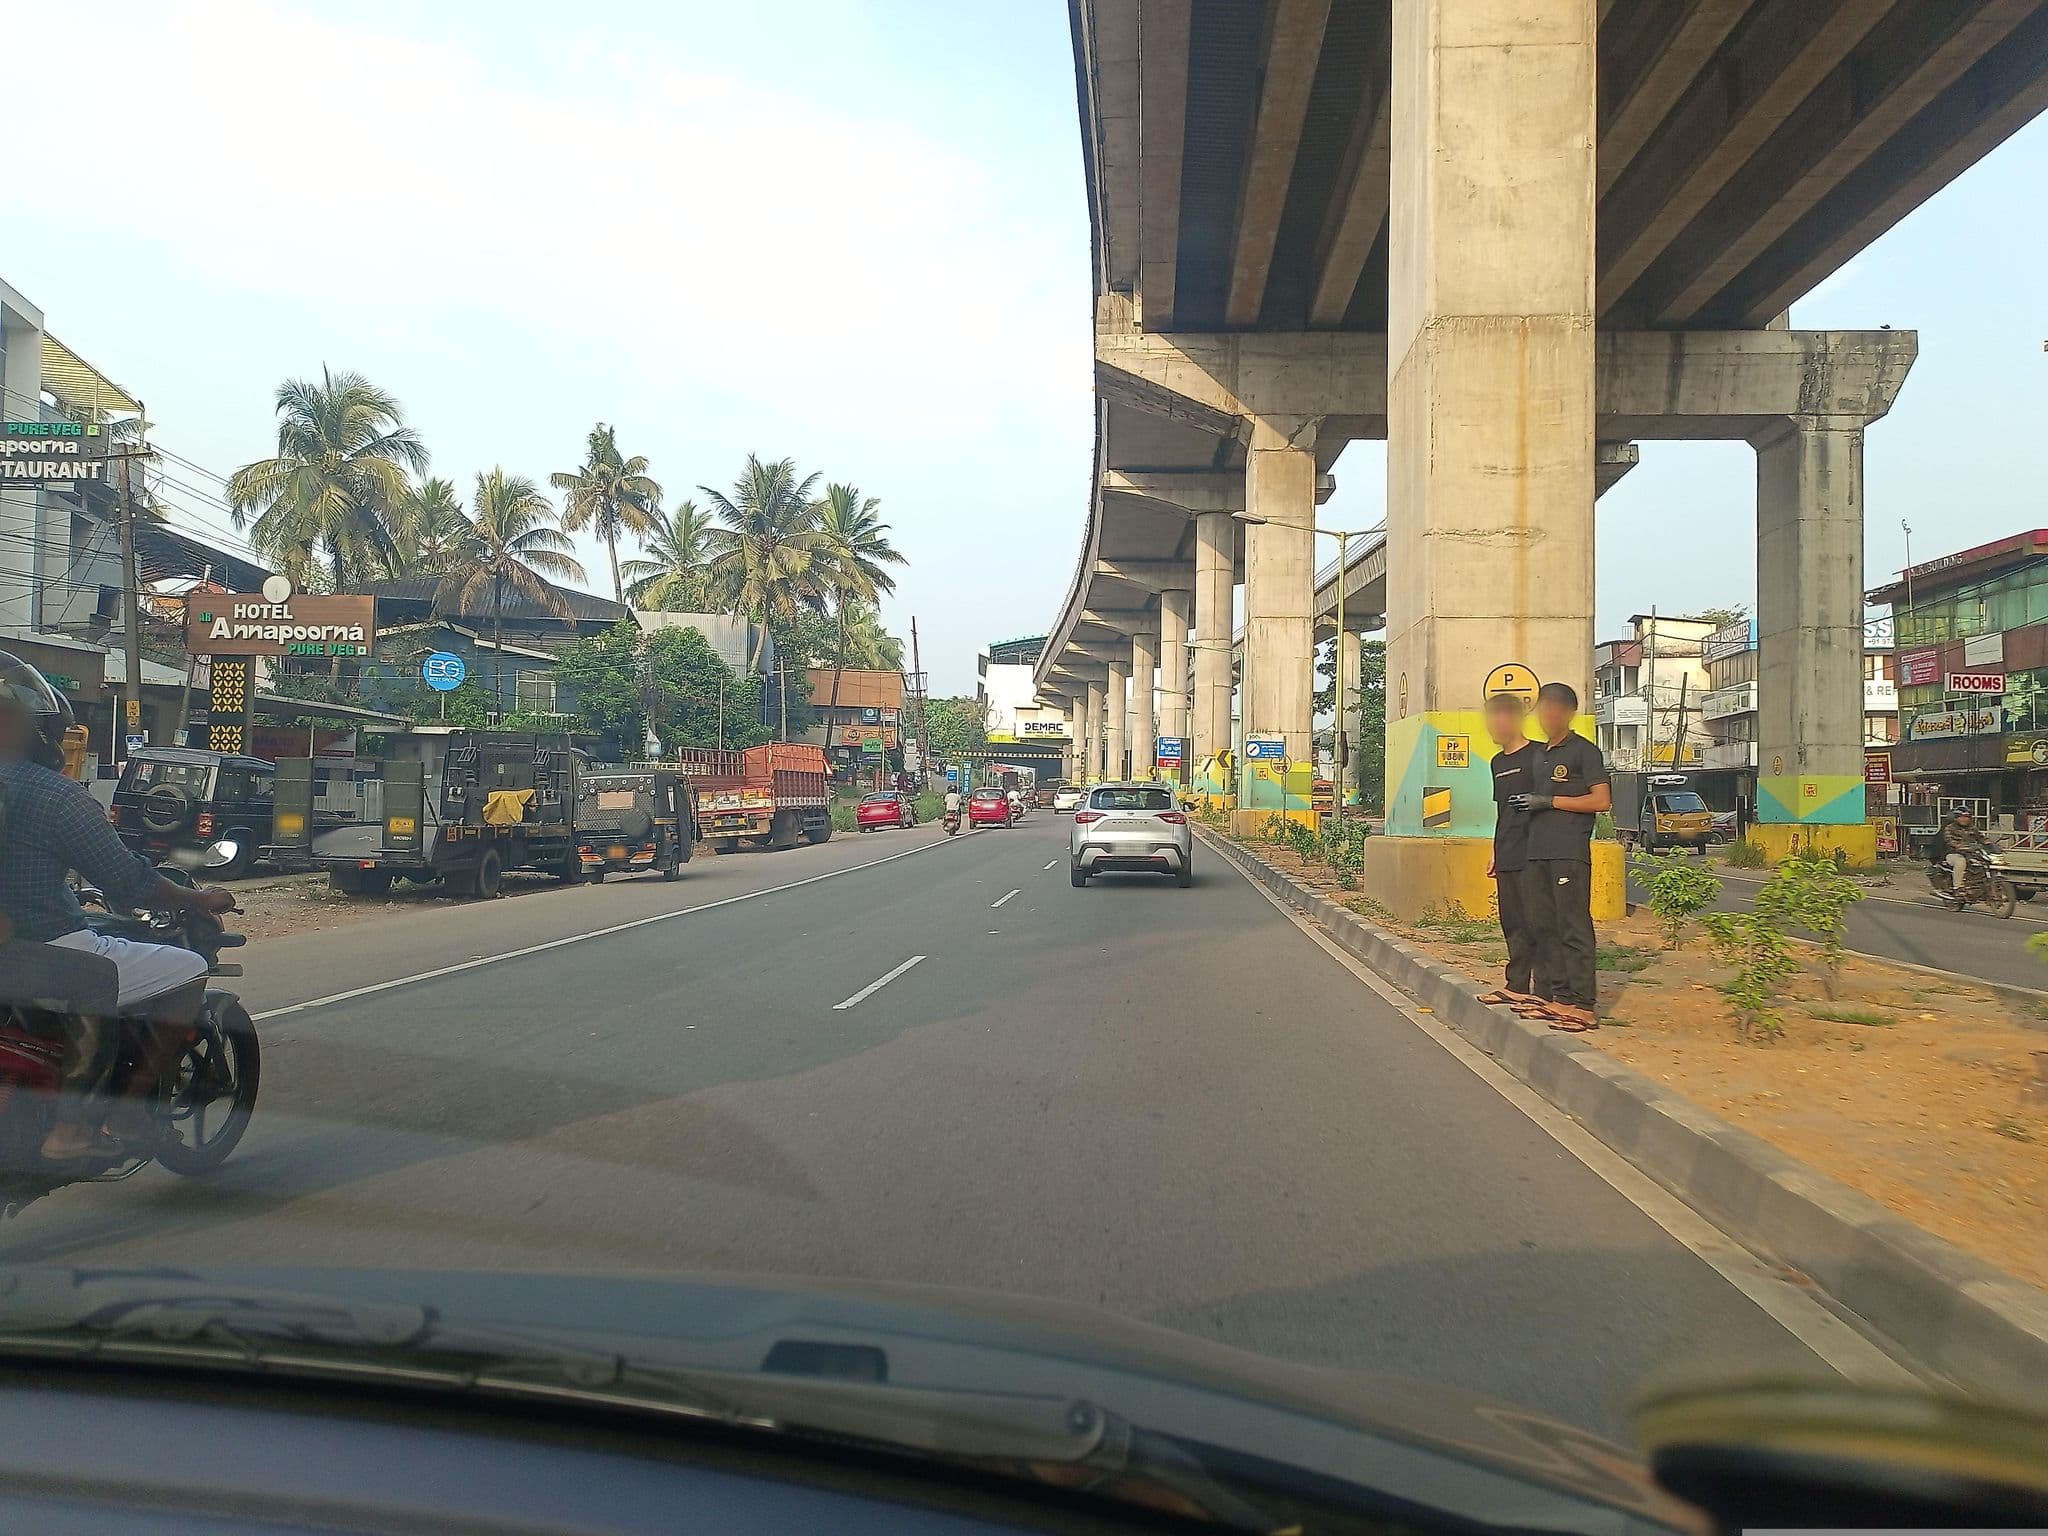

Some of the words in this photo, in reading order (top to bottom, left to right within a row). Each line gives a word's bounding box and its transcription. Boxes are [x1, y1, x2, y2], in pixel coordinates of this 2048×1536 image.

[7, 423, 49, 435] PURE
[51, 423, 82, 436] VEG
[0, 460, 103, 479] TAURANT
[233, 603, 294, 620] HOTEL
[209, 616, 364, 645] Annapoorna
[288, 643, 324, 655] PURE
[329, 644, 356, 657] VEG
[428, 660, 460, 678] BG
[1504, 674, 1514, 686] P
[1952, 676, 2001, 691] ROOMS
[1024, 722, 1064, 731] DEMAC
[1447, 742, 1459, 751] PP
